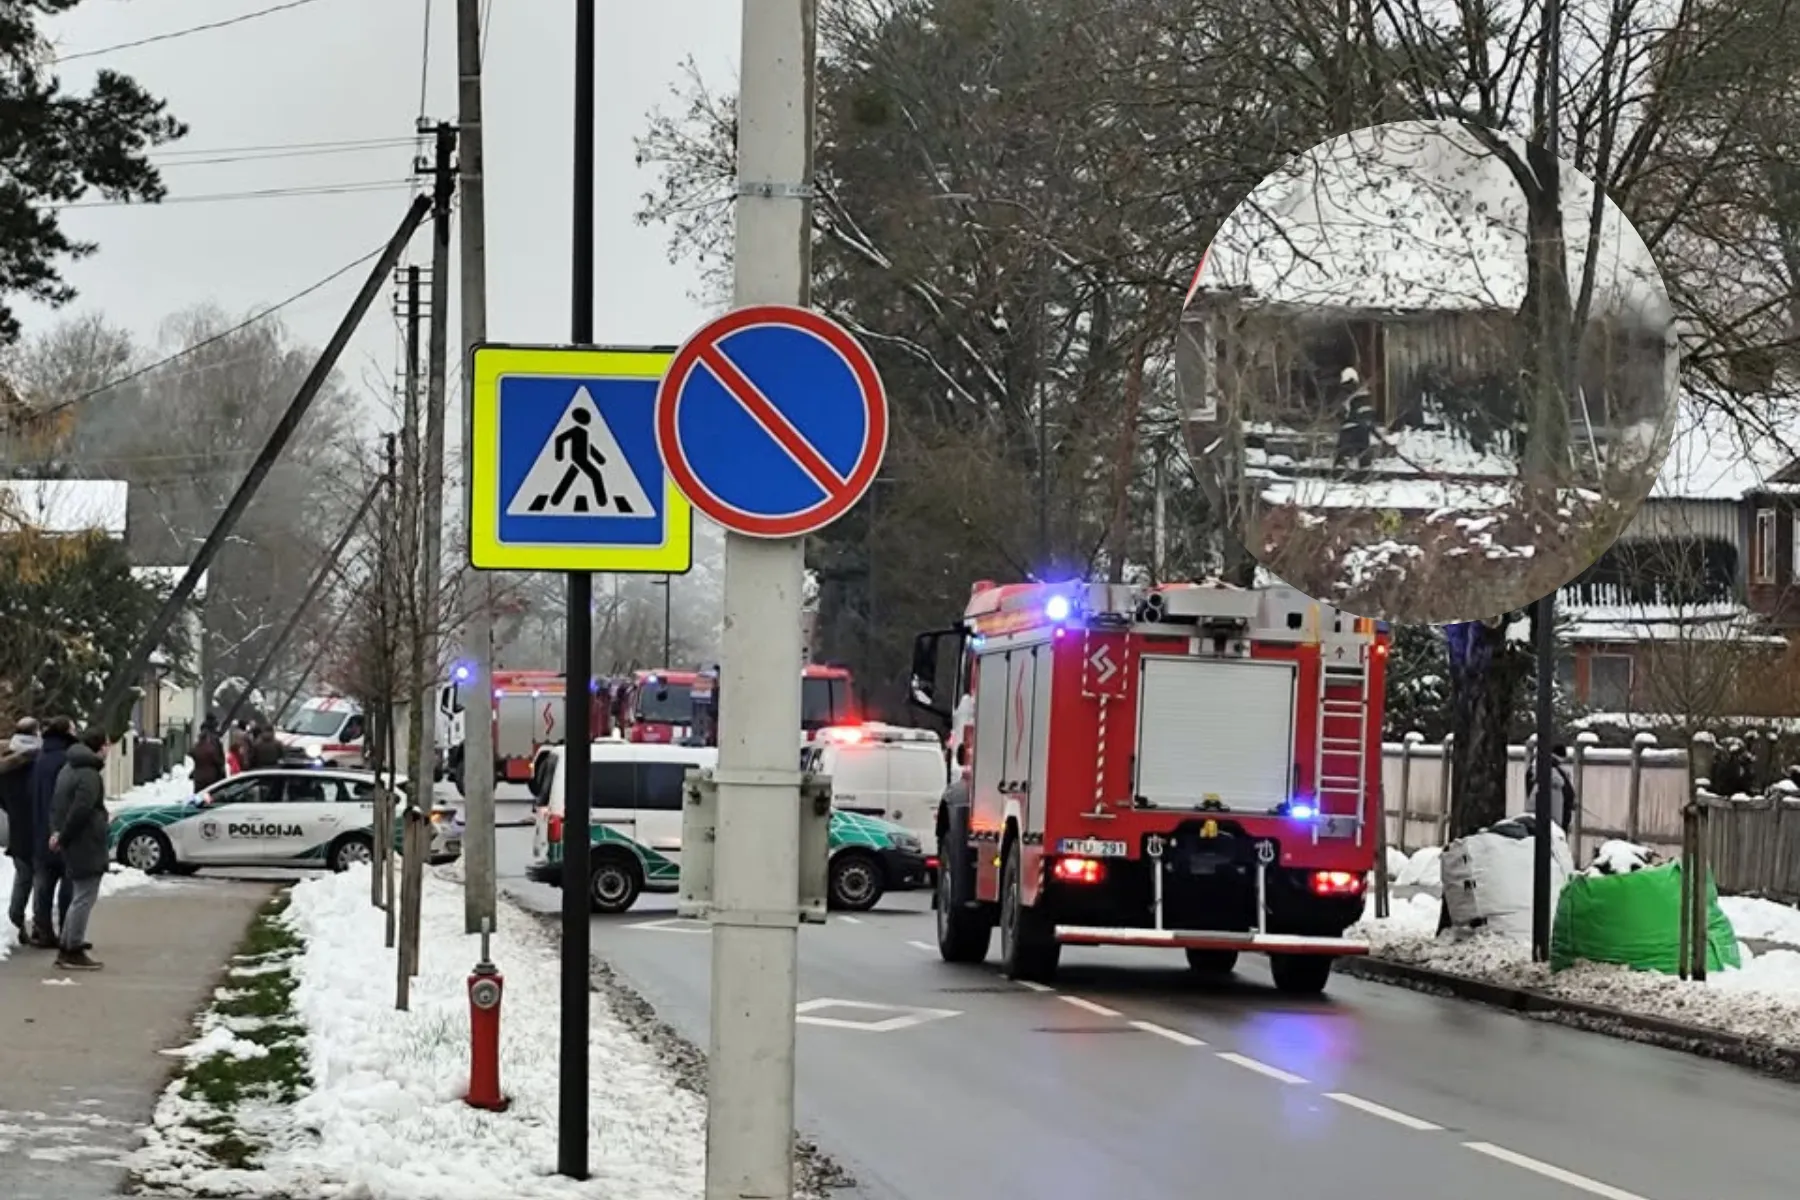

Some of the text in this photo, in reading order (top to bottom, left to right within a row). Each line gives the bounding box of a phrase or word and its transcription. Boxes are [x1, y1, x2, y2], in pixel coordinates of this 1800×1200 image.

[228, 823, 303, 836] POLICIJA
[1065, 841, 1124, 855] MTU 291
